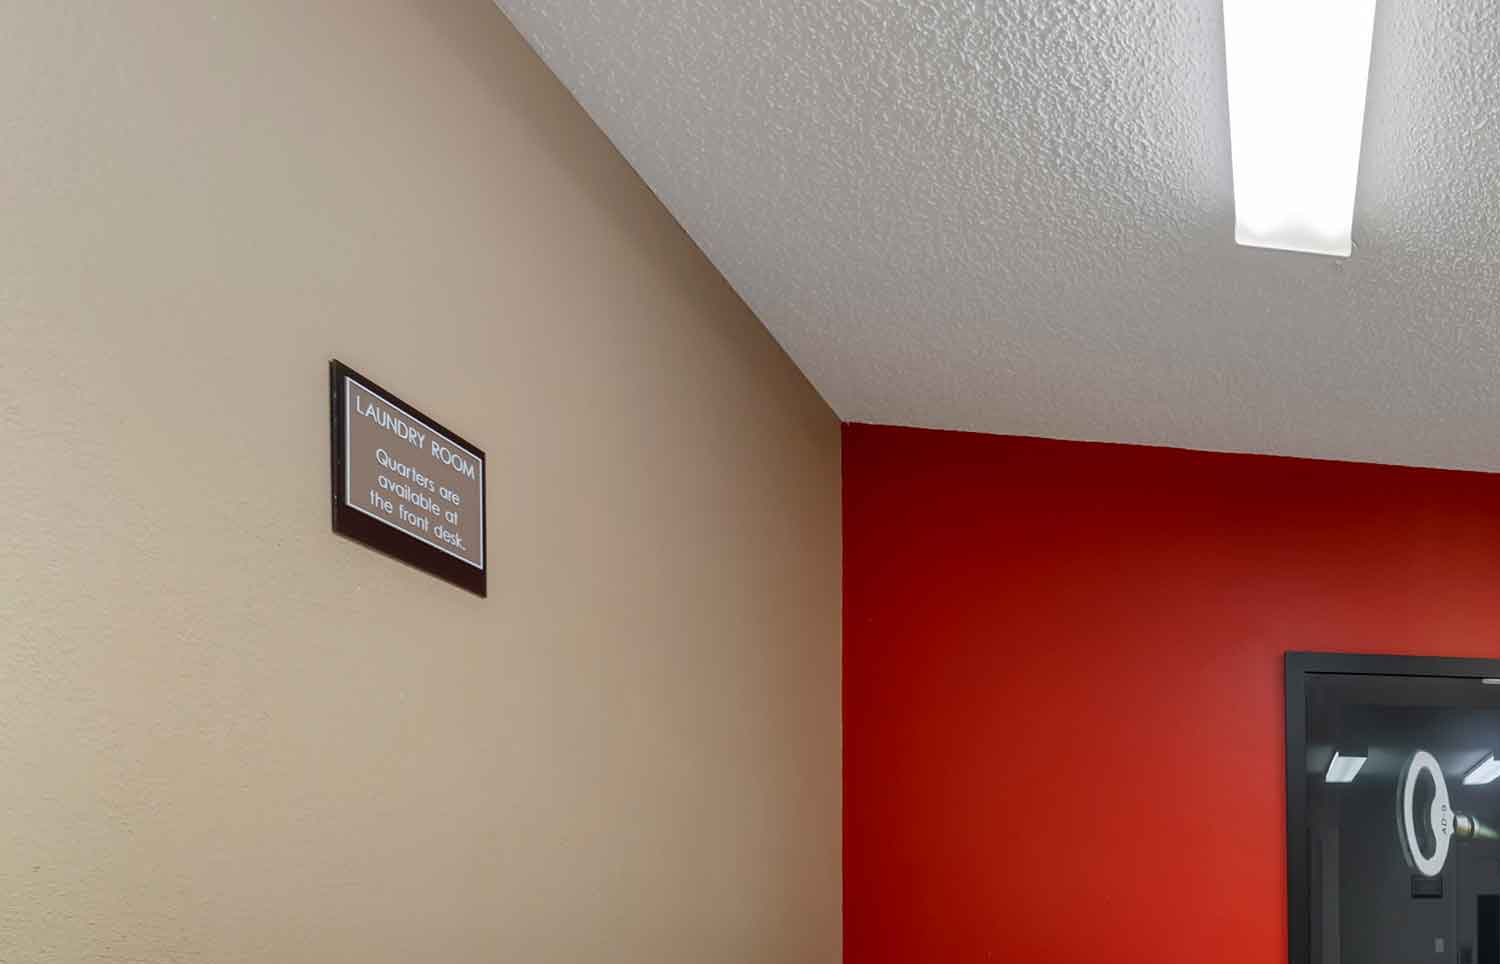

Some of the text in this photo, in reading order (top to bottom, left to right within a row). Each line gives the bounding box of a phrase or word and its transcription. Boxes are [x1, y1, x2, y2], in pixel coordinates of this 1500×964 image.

[356, 396, 475, 480] LAUNDRY ROOM
[376, 449, 460, 505] Quarters are
[378, 475, 458, 526] available at
[370, 490, 466, 550] the front desk.
